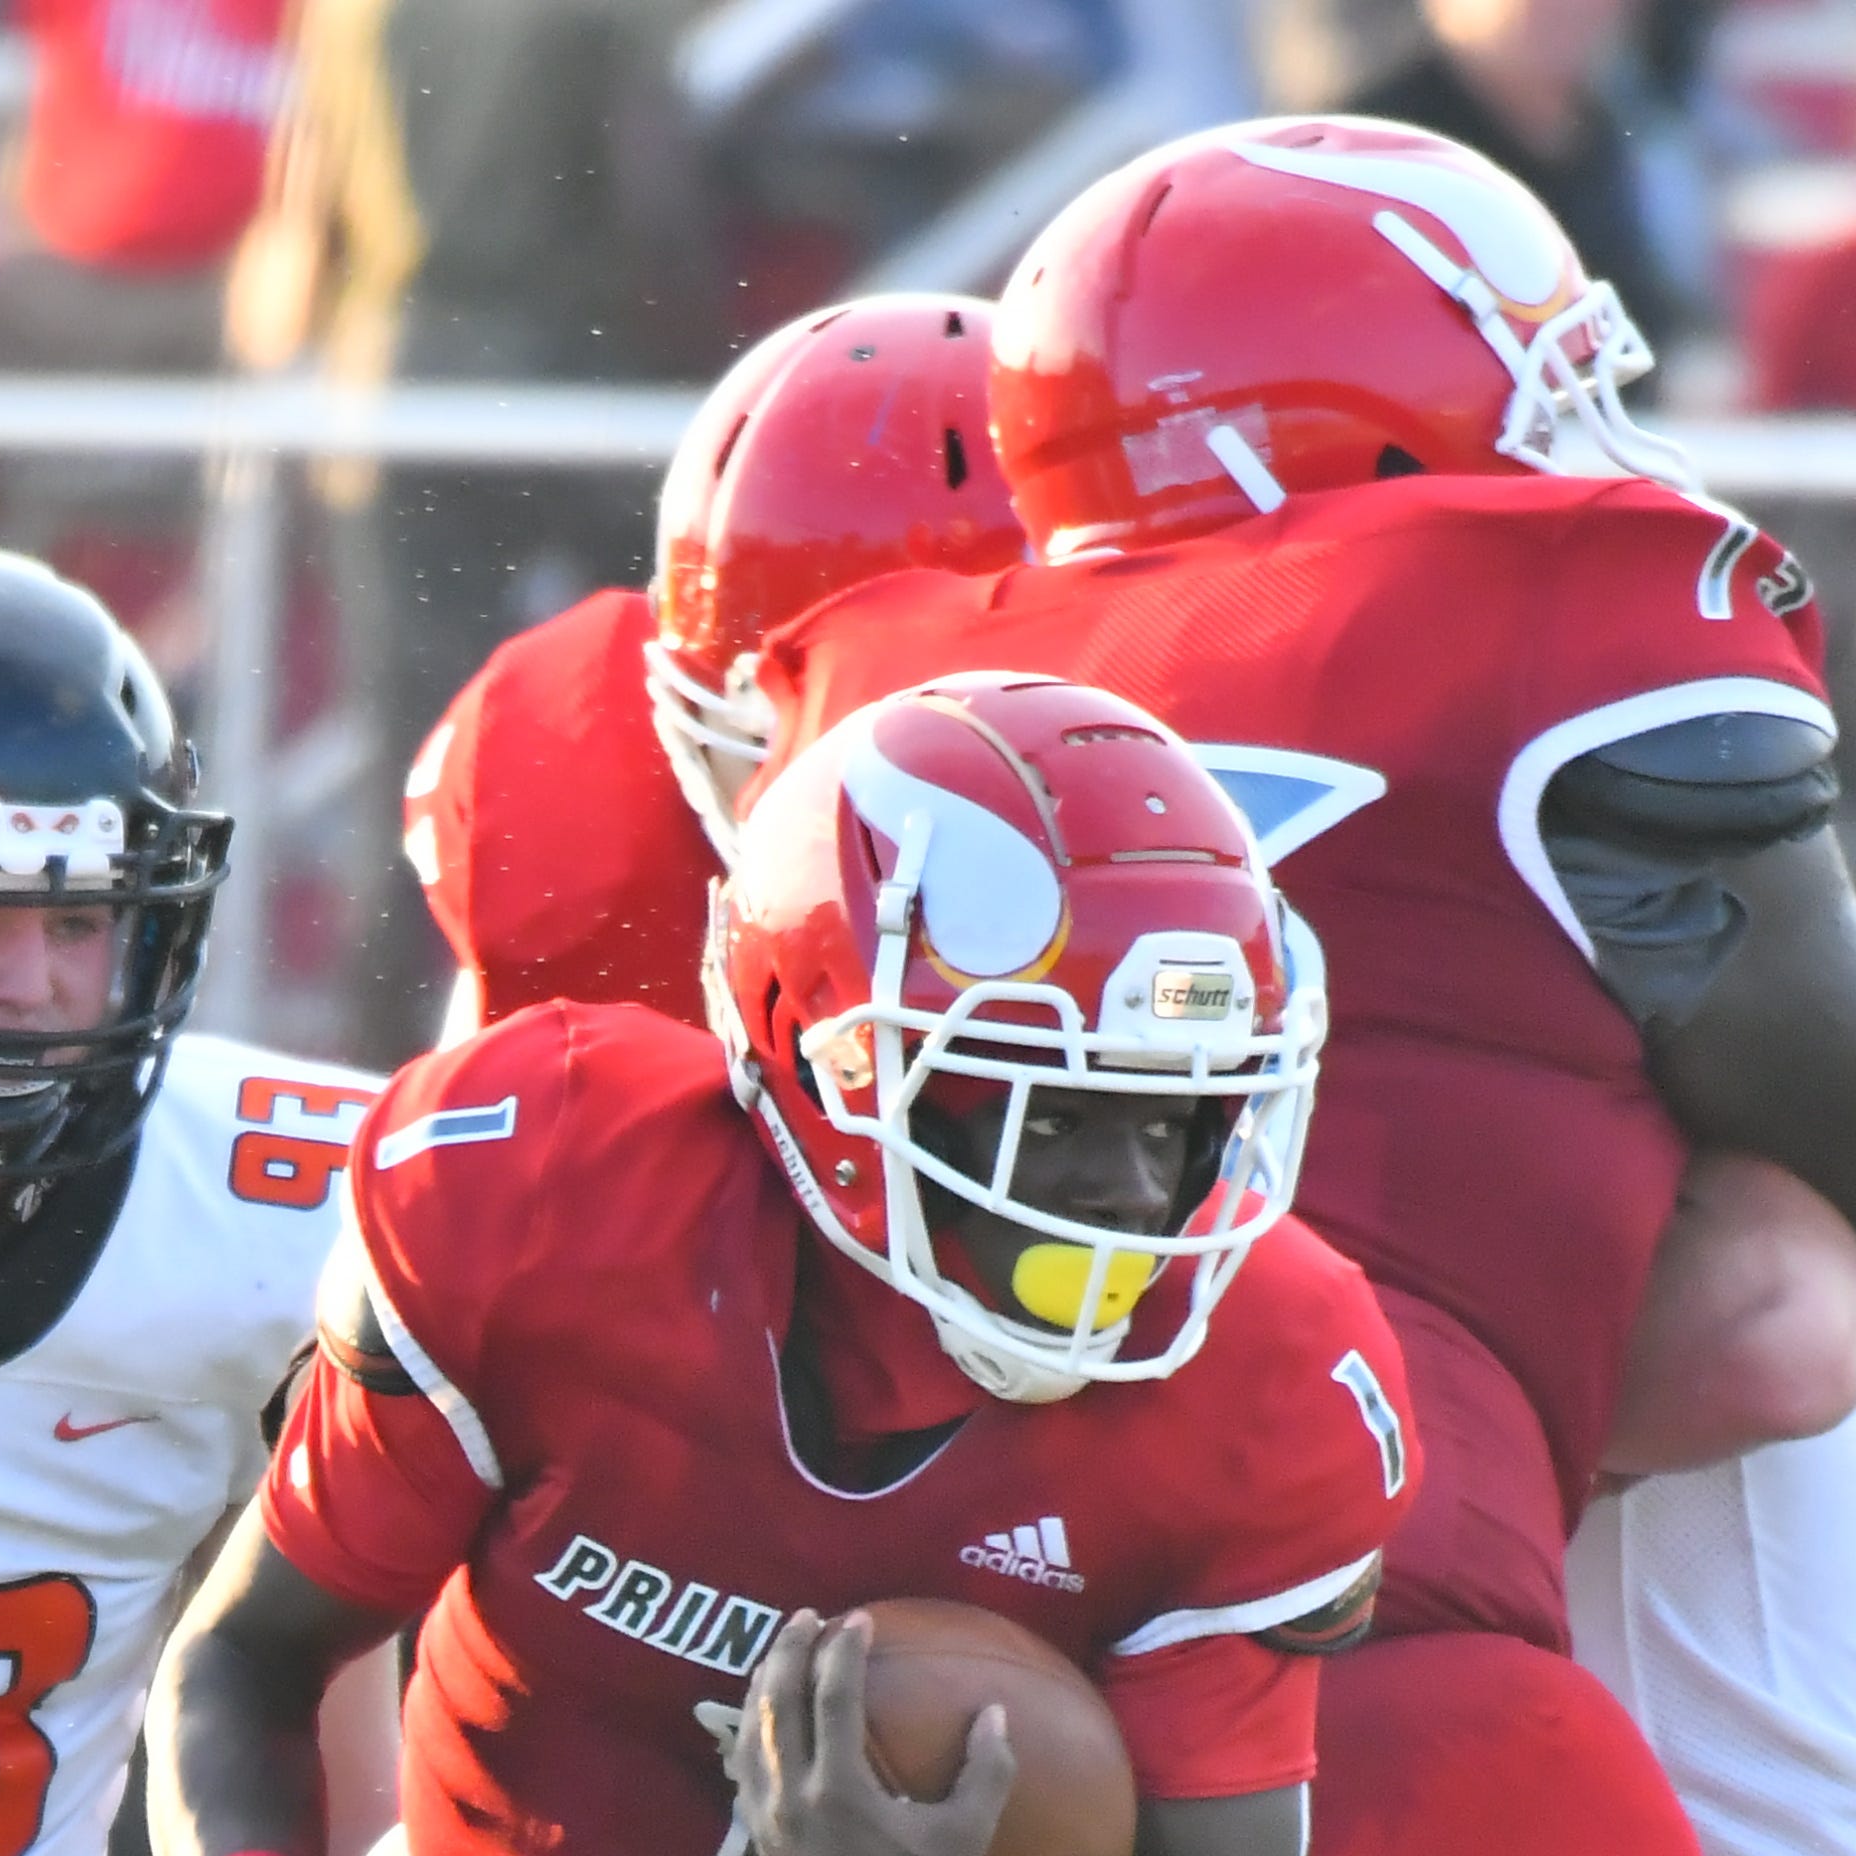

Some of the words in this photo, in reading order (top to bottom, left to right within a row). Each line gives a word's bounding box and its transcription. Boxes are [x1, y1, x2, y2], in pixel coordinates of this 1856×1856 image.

[1156, 983, 1231, 1008] schutt
[227, 1075, 382, 1213] 93
[374, 1094, 520, 1171] 1
[1330, 1348, 1406, 1500] 1
[959, 1545, 1085, 1594] adidas
